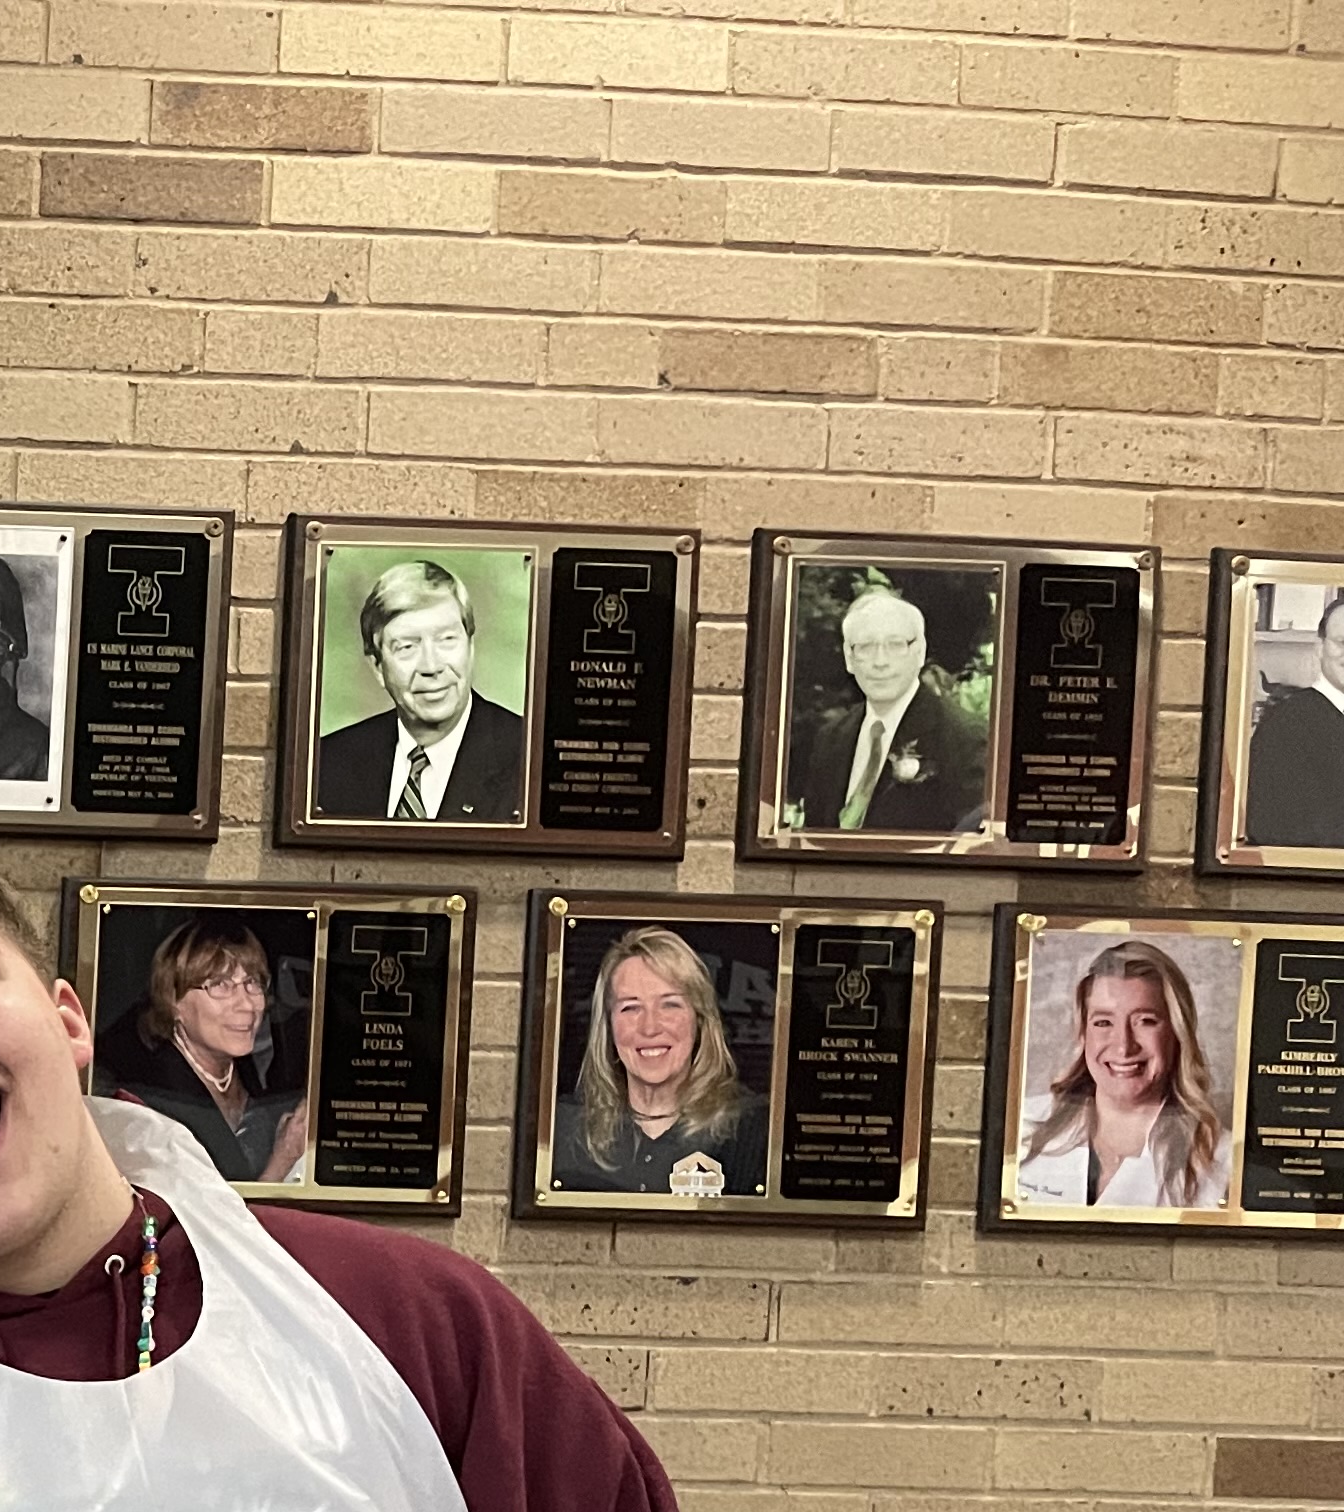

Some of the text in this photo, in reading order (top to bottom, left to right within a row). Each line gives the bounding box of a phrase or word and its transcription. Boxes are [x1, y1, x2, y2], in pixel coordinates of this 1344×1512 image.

[571, 661, 626, 673] DONALD
[577, 677, 636, 689] NEWMAN
[1030, 675, 1050, 686] DR.
[1059, 676, 1100, 688] PETER
[365, 1023, 403, 1034] LINDA
[363, 1039, 404, 1050] FOELS
[821, 1037, 859, 1048] KAREN
[799, 1051, 837, 1061] BROCK
[1281, 1051, 1338, 1062] KIMBERLY
[351, 1059, 376, 1067] CLASS
